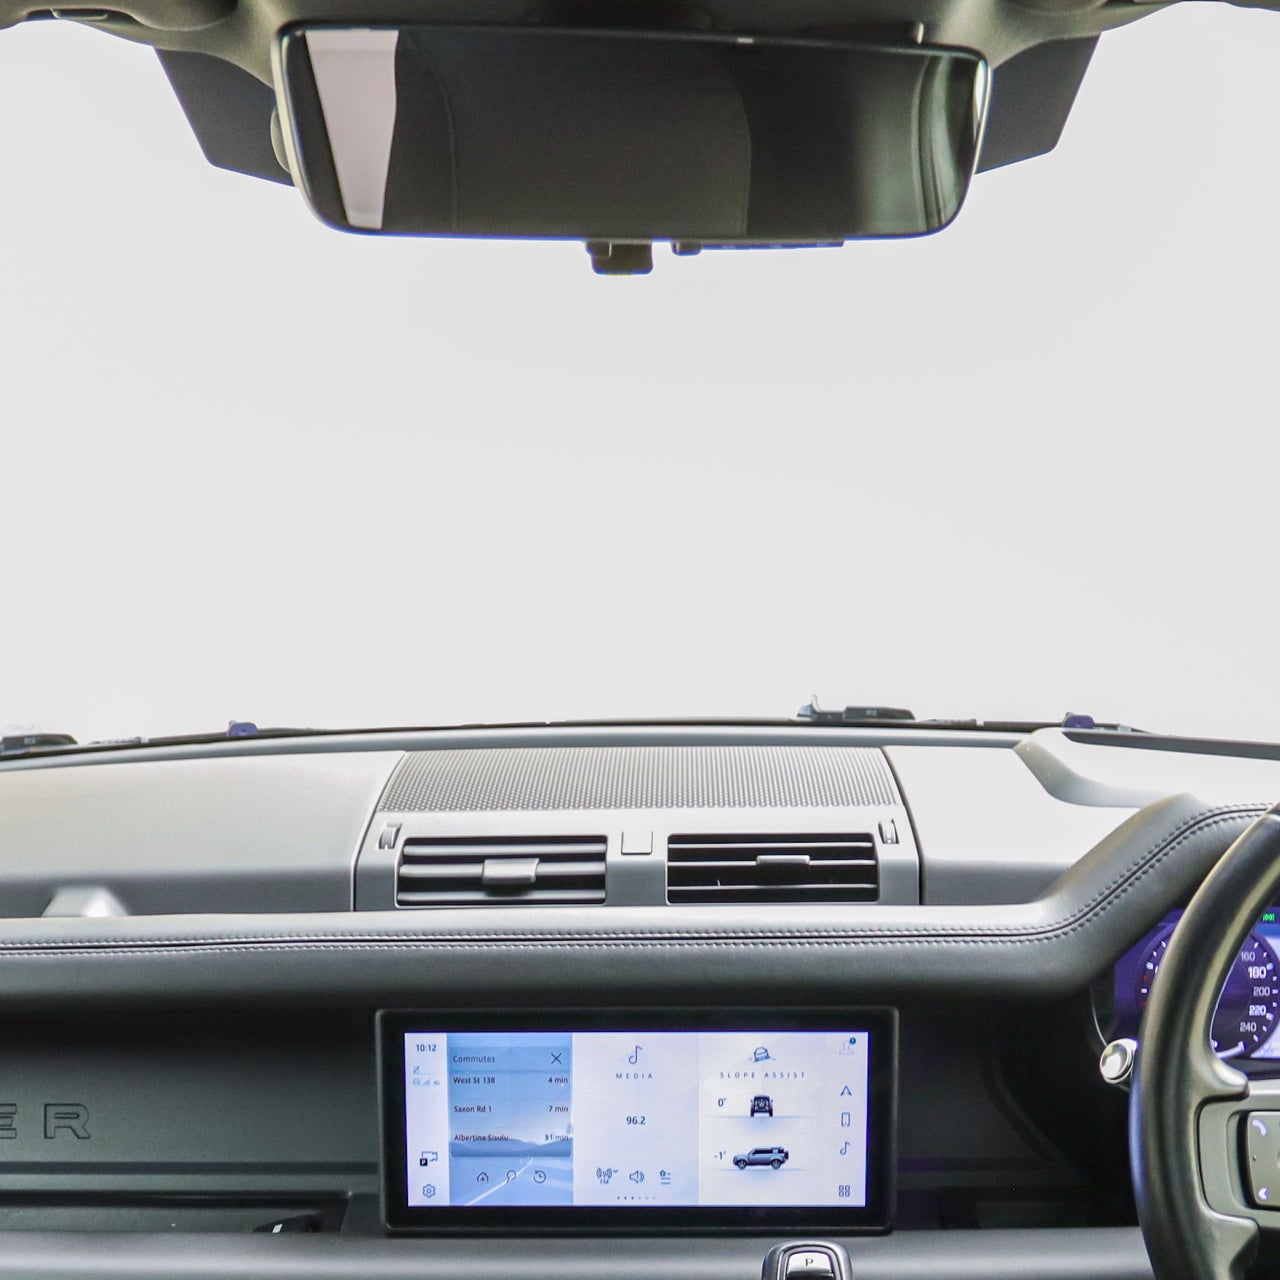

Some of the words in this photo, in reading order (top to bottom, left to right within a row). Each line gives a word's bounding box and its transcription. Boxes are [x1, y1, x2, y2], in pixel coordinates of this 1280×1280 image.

[1240, 951, 1256, 962] 160
[1247, 966, 1267, 979] 180
[1253, 986, 1270, 996] 200
[1248, 1005, 1267, 1016] 220
[1239, 1022, 1257, 1032] 240
[415, 1044, 437, 1052] 10:12
[452, 1055, 496, 1063] Commutes
[453, 1105, 475, 1113] Saxon
[476, 1105, 486, 1113] Rd
[554, 1105, 569, 1113] min
[626, 1115, 646, 1126] 96.2
[454, 1134, 486, 1142] Albertina
[805, 1257, 814, 1267] P
